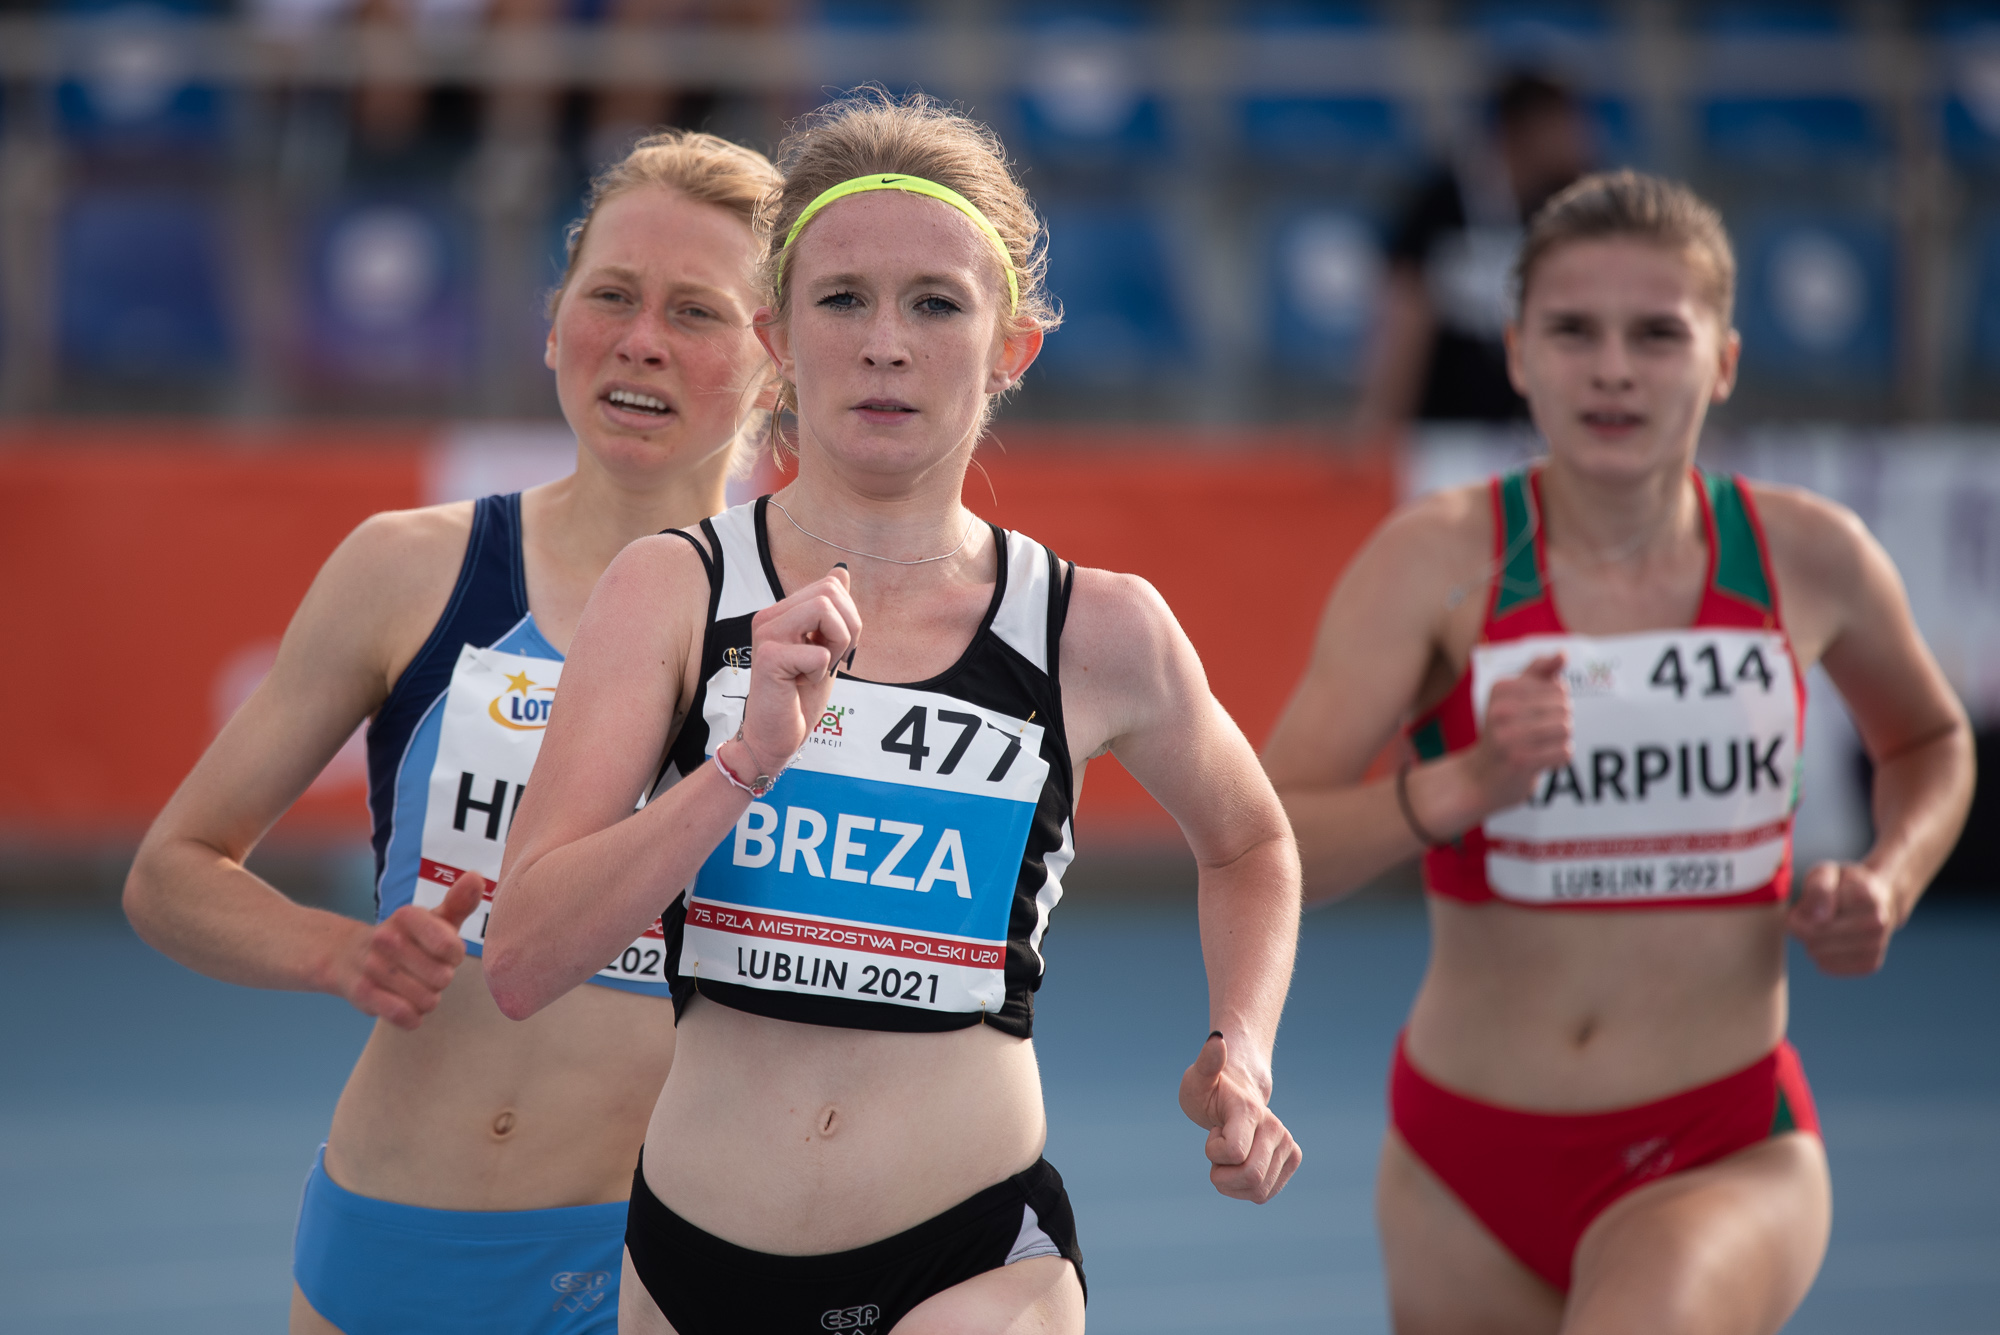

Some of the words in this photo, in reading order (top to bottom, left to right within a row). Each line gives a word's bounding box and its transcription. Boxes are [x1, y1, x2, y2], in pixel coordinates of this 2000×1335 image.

[1650, 644, 1775, 701] 414
[880, 705, 1023, 783] 477
[1527, 735, 1786, 807] ARPIUK
[732, 801, 973, 900] BREZA
[1551, 863, 1655, 897] LUBLIN
[1663, 859, 1734, 893] 2021
[694, 908, 713, 924] 75.
[716, 912, 754, 931] PZLA
[758, 919, 897, 951] MISTRZOSTWA
[900, 939, 967, 960] POLSKI
[970, 949, 999, 964] U20
[737, 946, 849, 991] LUBLIN
[857, 964, 939, 1004] 2021
[820, 1303, 880, 1330] ESA
